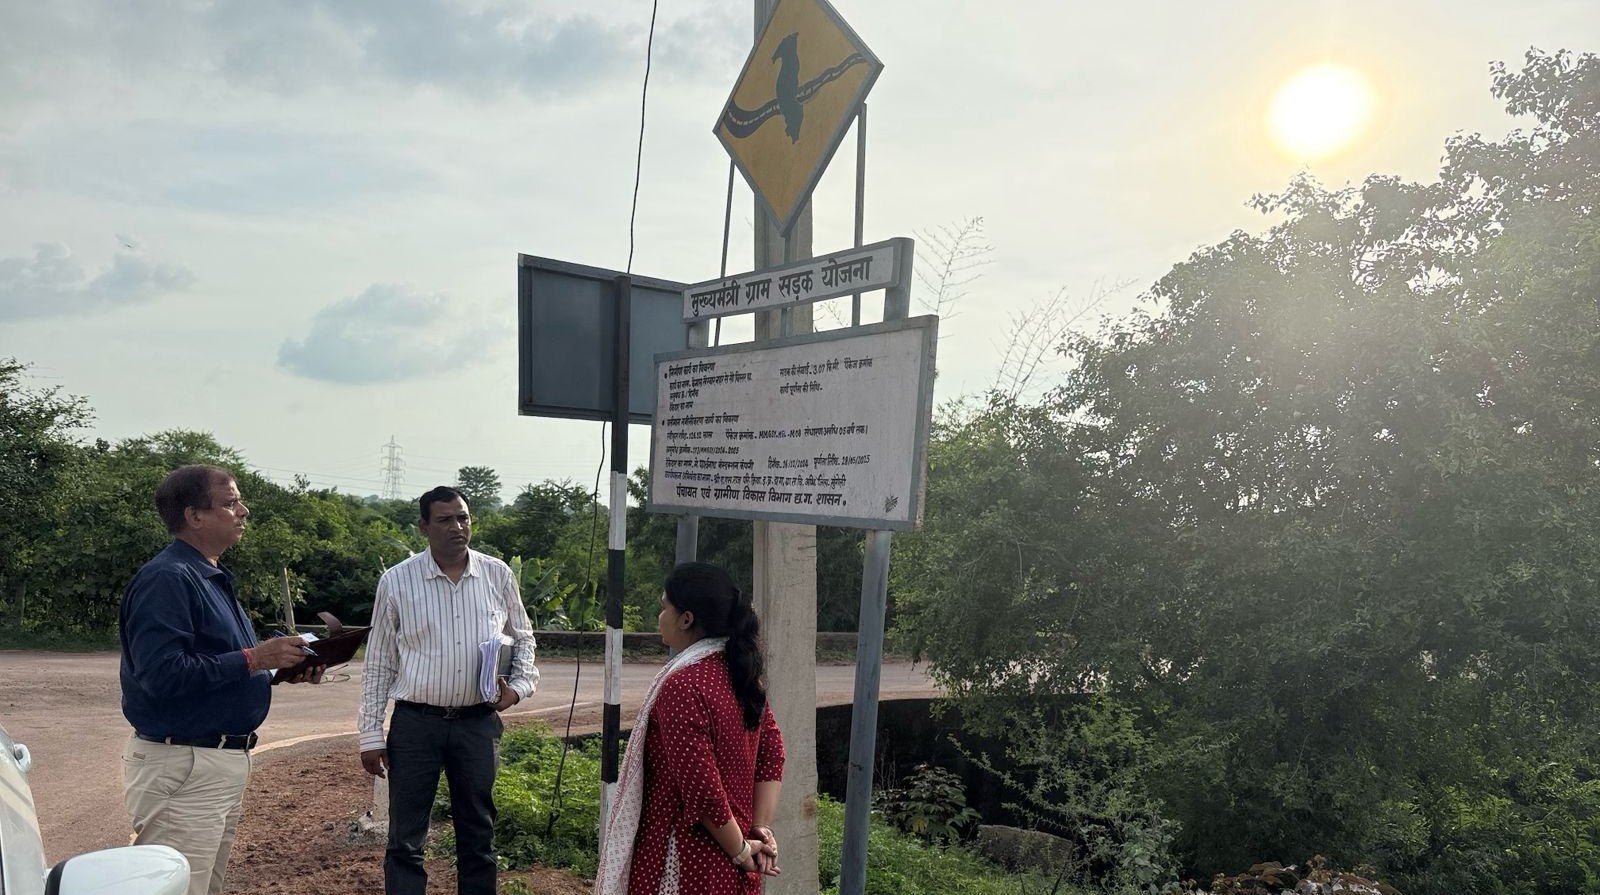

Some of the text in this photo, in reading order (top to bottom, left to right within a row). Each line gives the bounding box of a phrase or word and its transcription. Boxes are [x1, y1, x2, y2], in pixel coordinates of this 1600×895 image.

[691, 256, 872, 316] मुख्यमंत्री ग्राम सड़क योजना
[676, 483, 698, 498] पंचायत
[701, 486, 711, 499] एवं
[714, 485, 740, 500] ग्रामीण
[743, 486, 766, 502] विकास
[768, 488, 792, 503] विभाग
